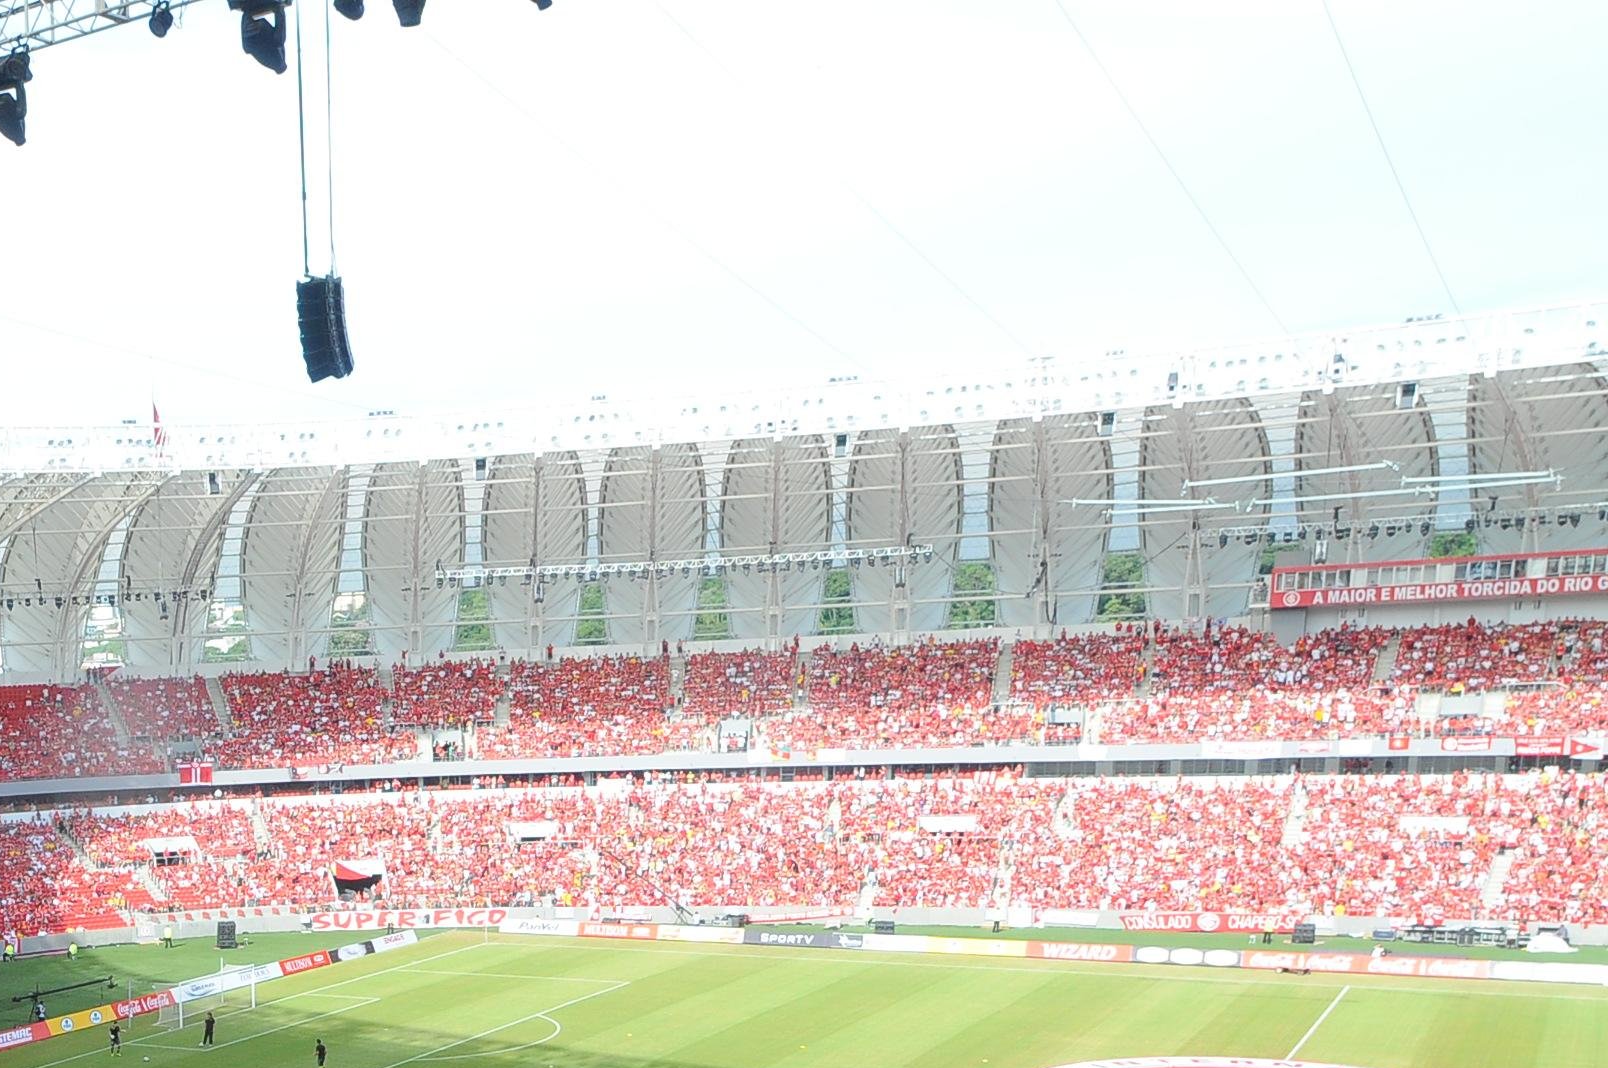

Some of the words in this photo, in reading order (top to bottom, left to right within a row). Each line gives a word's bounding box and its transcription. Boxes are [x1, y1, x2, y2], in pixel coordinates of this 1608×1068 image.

[1312, 591, 1324, 605] A
[1327, 588, 1376, 603] MAIOR
[1381, 587, 1390, 600] E
[1394, 584, 1458, 602] MELHOR
[1462, 579, 1533, 597] TORCIDA
[1536, 578, 1560, 594] DO
[1564, 576, 1593, 592] RIO
[313, 909, 418, 929] SUPER
[1125, 914, 1193, 929] CONSULADO
[1042, 942, 1117, 960] WIZARD
